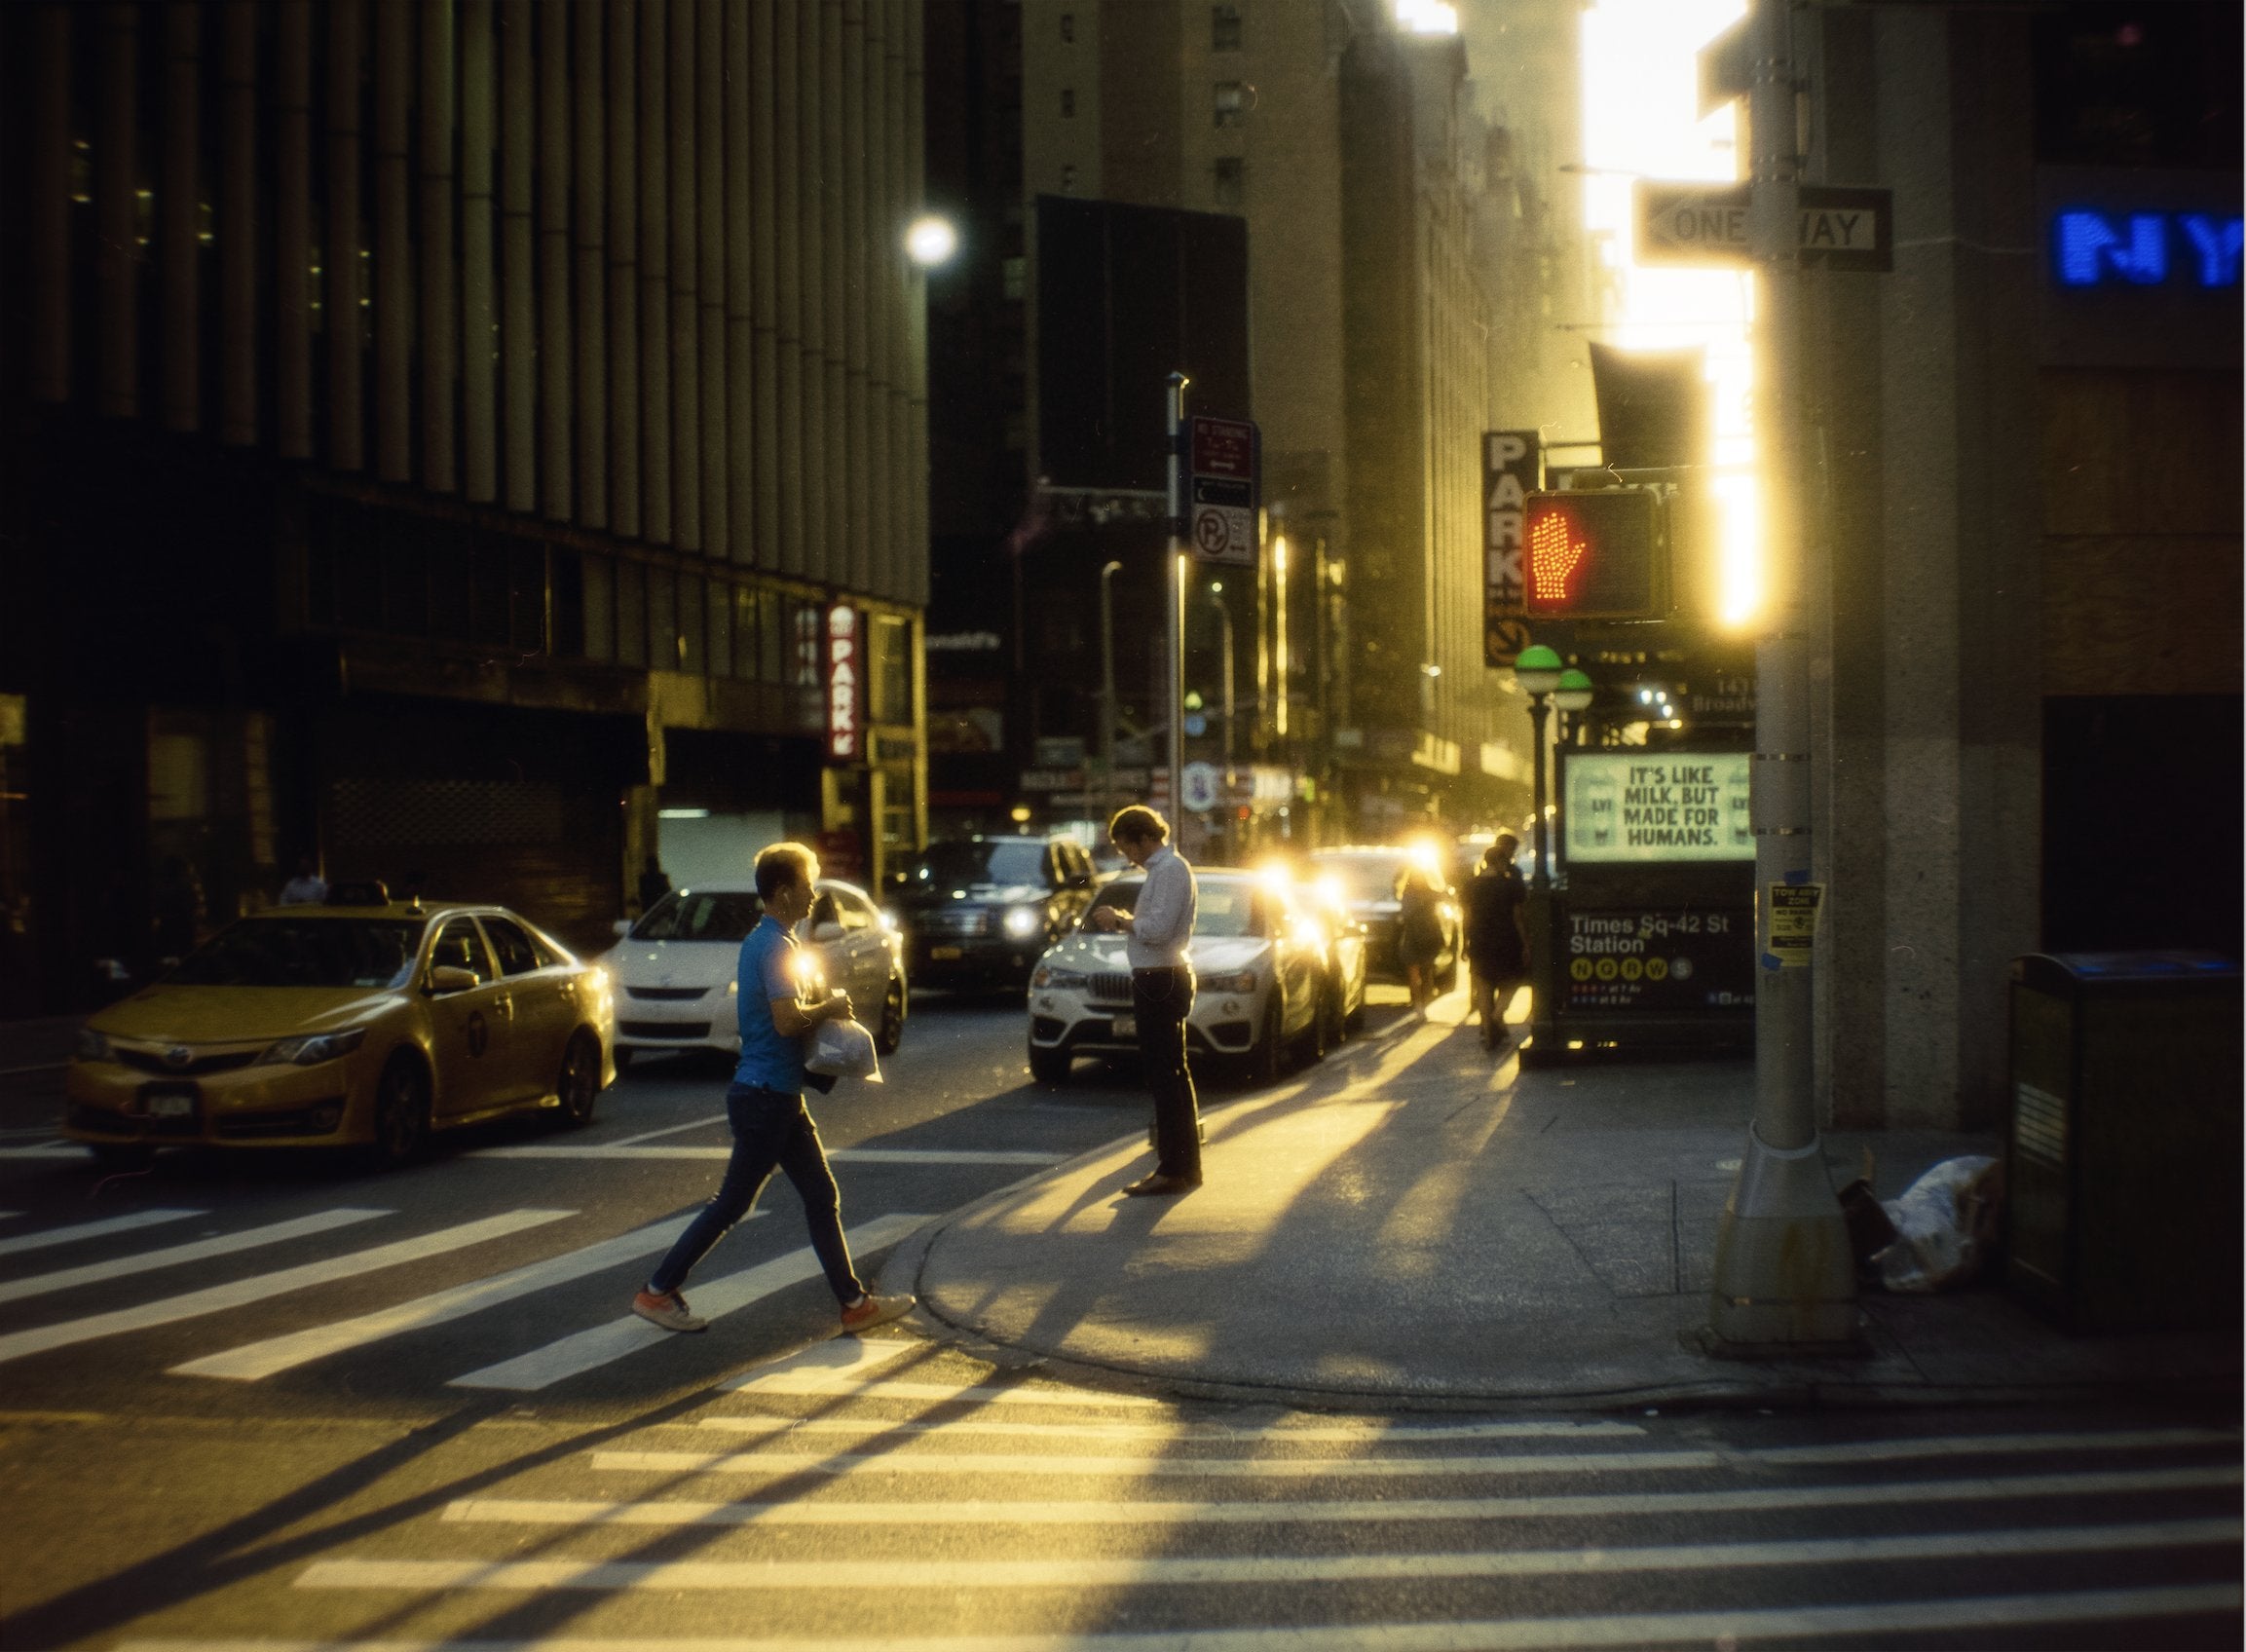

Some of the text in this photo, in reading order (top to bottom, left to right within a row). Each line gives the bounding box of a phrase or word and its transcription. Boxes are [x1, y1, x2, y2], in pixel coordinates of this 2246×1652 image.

[1674, 206, 1748, 243] ONE
[1489, 435, 1526, 585] PARK
[831, 638, 855, 732] PARK
[1629, 766, 1714, 784] IT'S LIKE
[1682, 787, 1719, 805] BUT
[1624, 807, 1719, 826] MADE FOR
[1627, 828, 1718, 846] HUMANS.
[1571, 914, 1731, 938] Times Sq-42 St
[1569, 935, 1645, 955] Station
